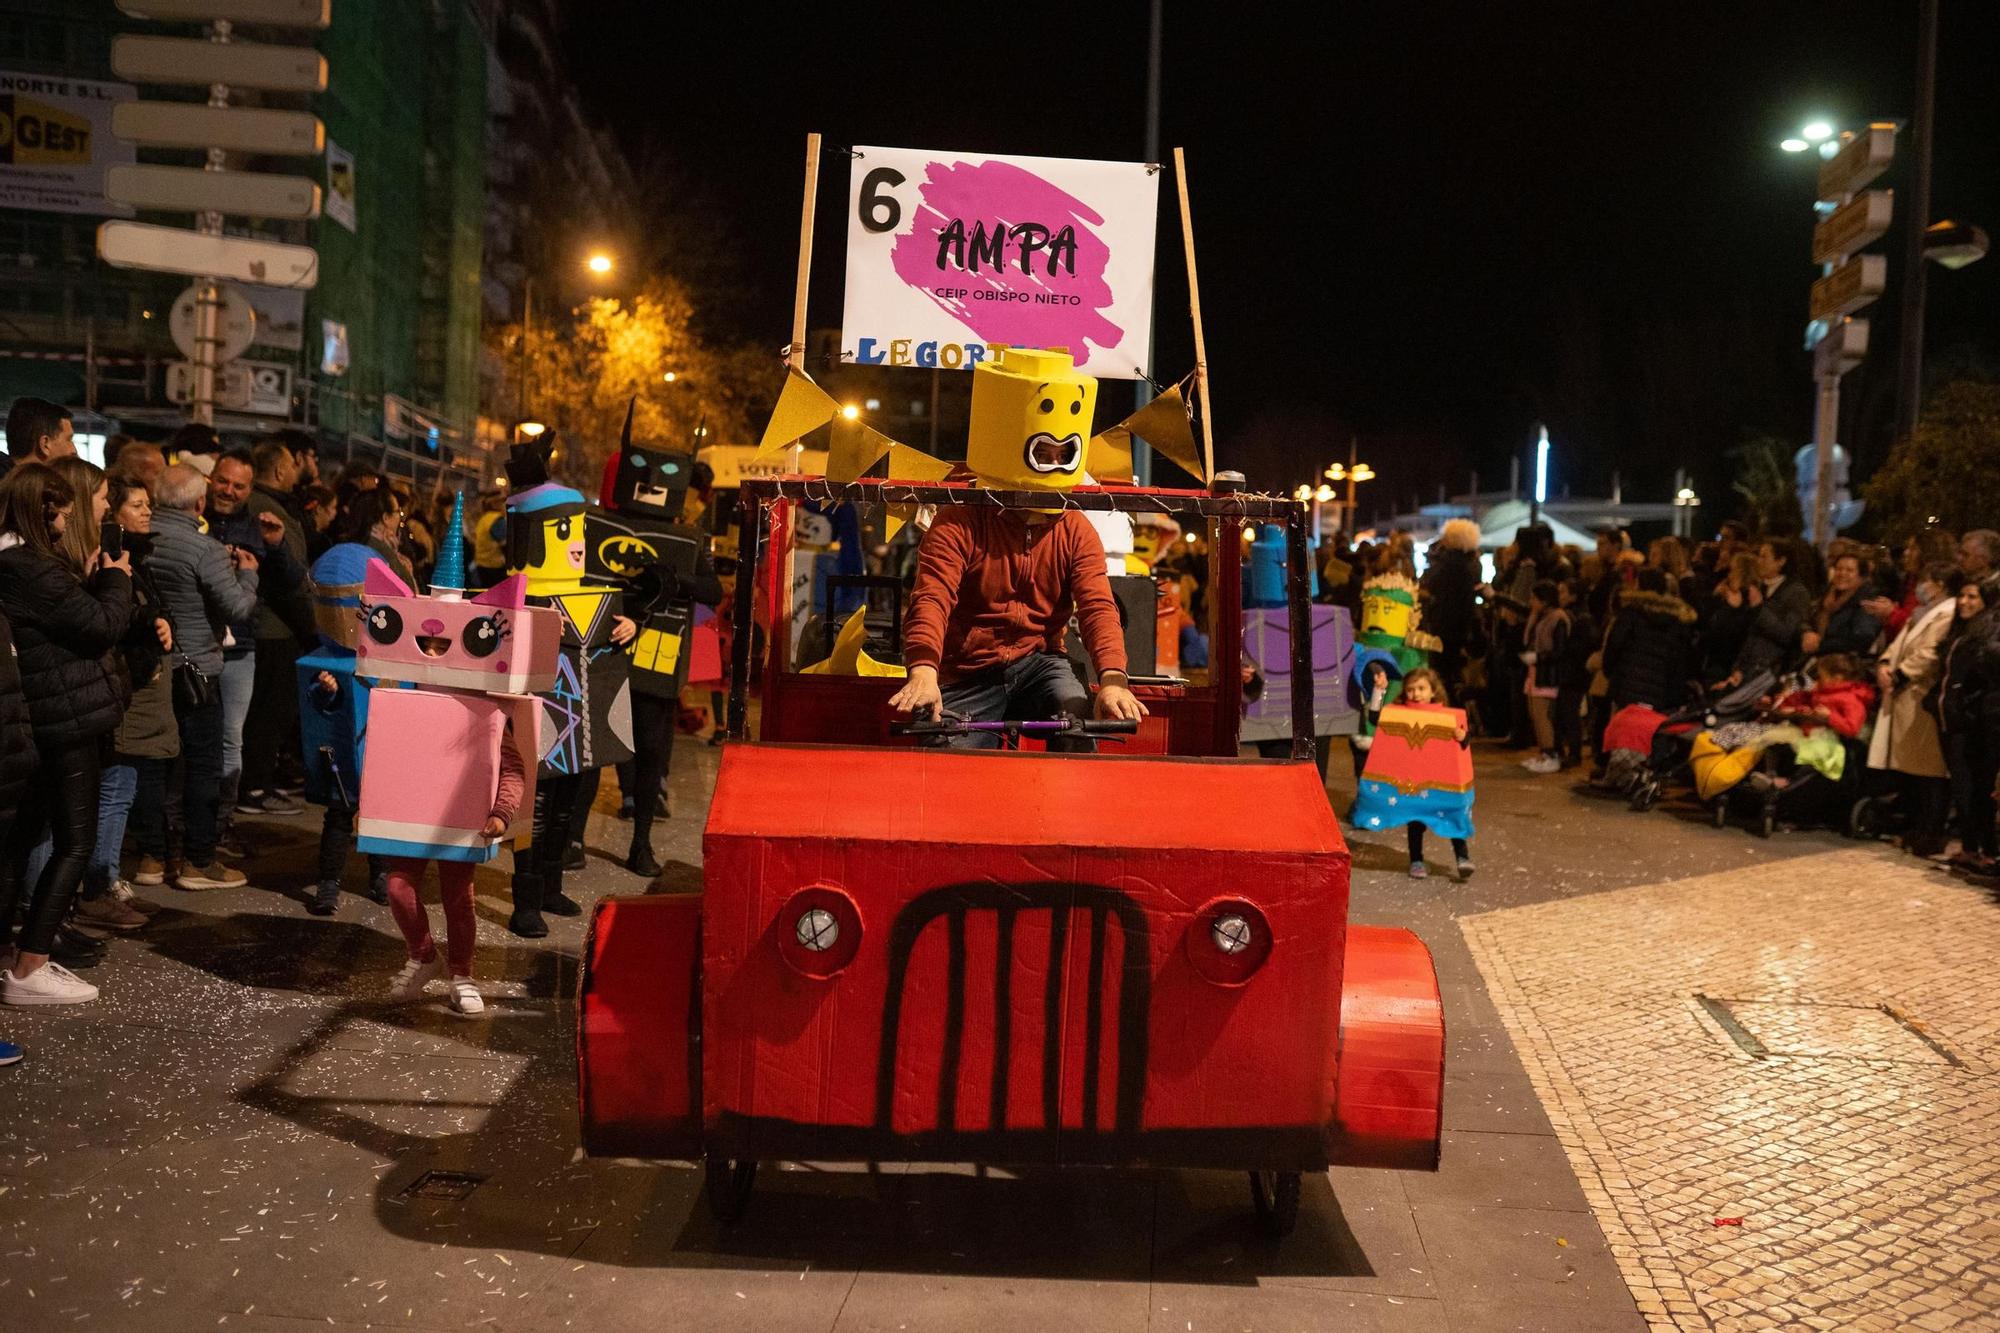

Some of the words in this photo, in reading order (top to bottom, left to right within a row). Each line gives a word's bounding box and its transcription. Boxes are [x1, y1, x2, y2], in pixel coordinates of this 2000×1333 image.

[858, 166, 907, 233] 6
[936, 217, 1079, 278] AMPA
[935, 287, 968, 300] CEIP
[973, 289, 1030, 303] OBISPO
[1035, 292, 1081, 306] NIETO
